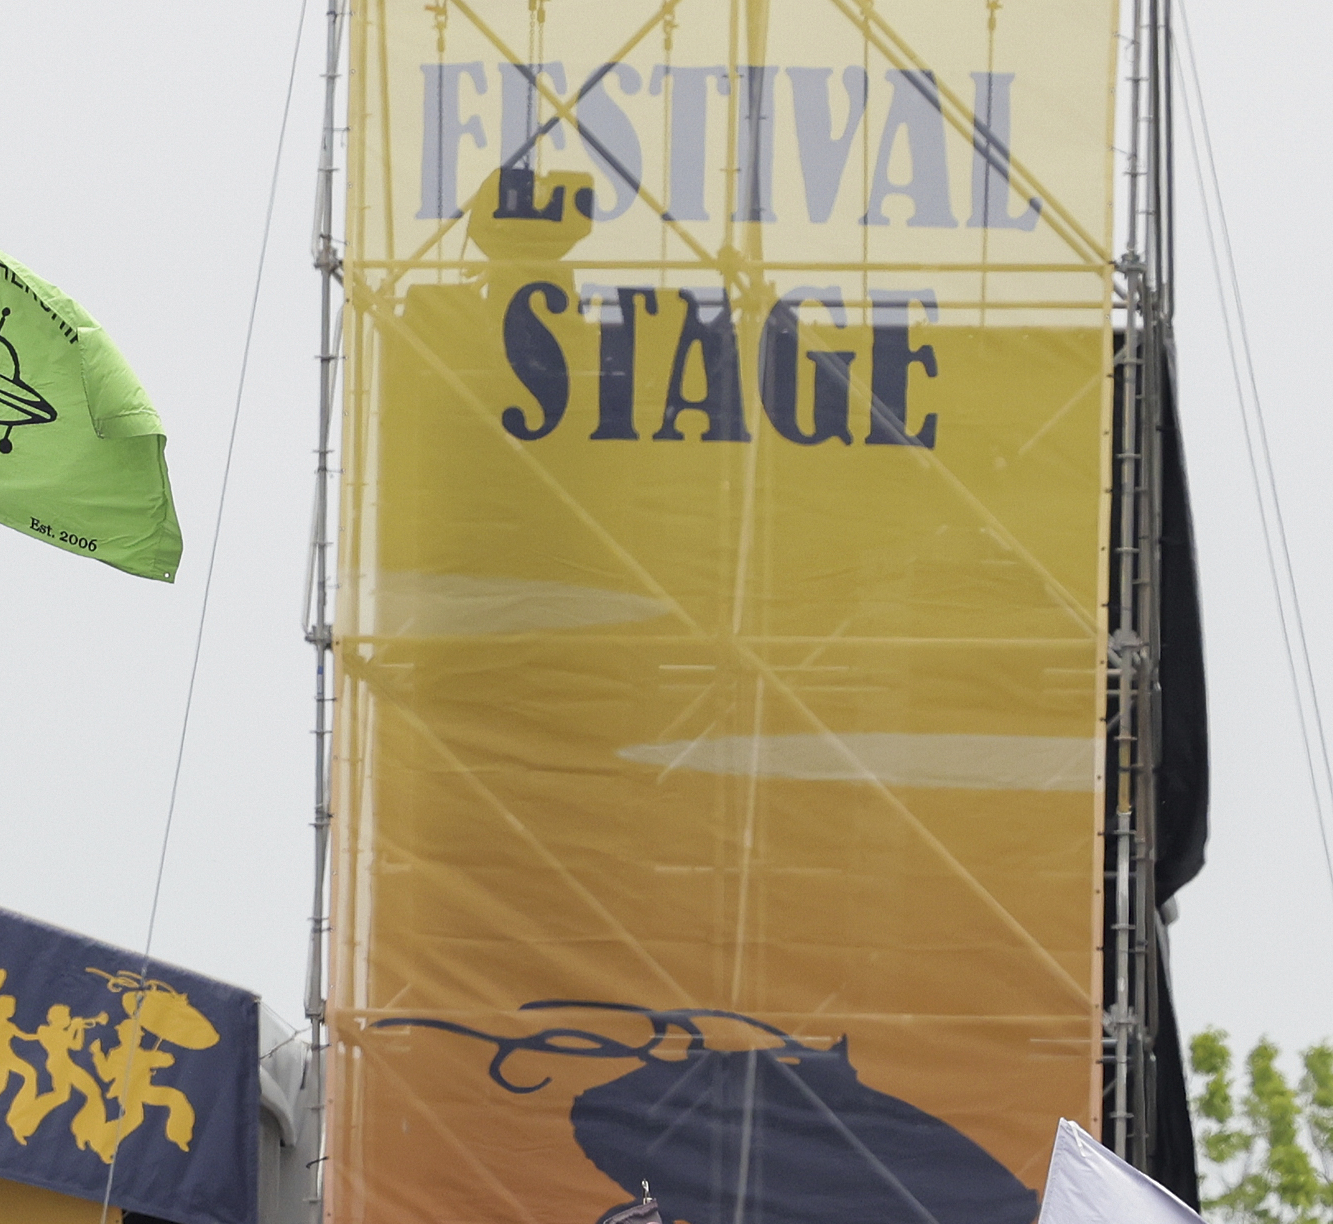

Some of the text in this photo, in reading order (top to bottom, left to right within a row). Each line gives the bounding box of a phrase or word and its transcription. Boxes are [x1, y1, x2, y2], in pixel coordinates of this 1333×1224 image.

[414, 61, 1039, 232] FESTIVAL
[500, 280, 939, 447] STAGE
[30, 516, 97, 552] Est. 2006
